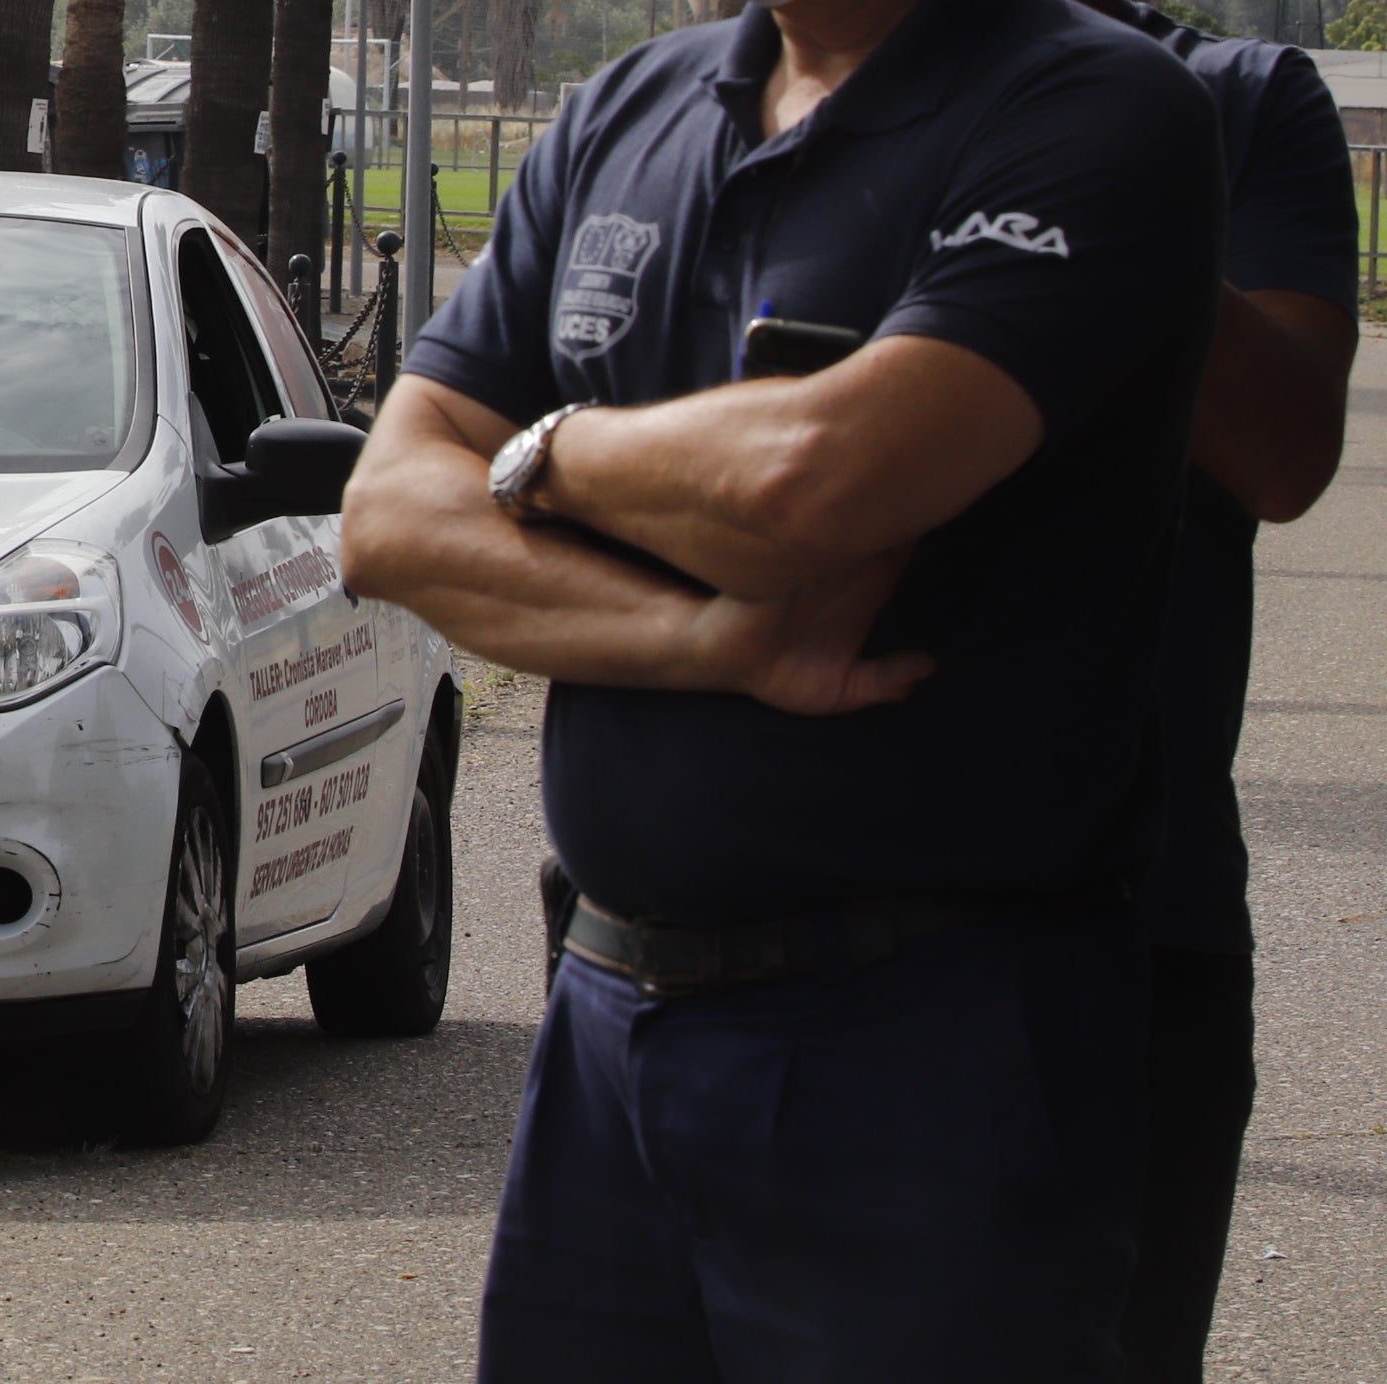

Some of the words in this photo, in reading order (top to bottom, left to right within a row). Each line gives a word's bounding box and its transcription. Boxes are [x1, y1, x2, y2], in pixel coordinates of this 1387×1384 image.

[250, 662, 283, 702] TALLER:
[284, 652, 316, 688] Cronista
[353, 623, 373, 657] LOCAL
[305, 688, 338, 728] CÓRDOBA
[255, 800, 276, 843] 957
[274, 792, 293, 835] 251
[319, 777, 338, 818] 607
[336, 770, 354, 810] 501
[250, 855, 288, 899] SERVICIO
[286, 839, 321, 883] URGENTE
[327, 826, 354, 862] HORAS
